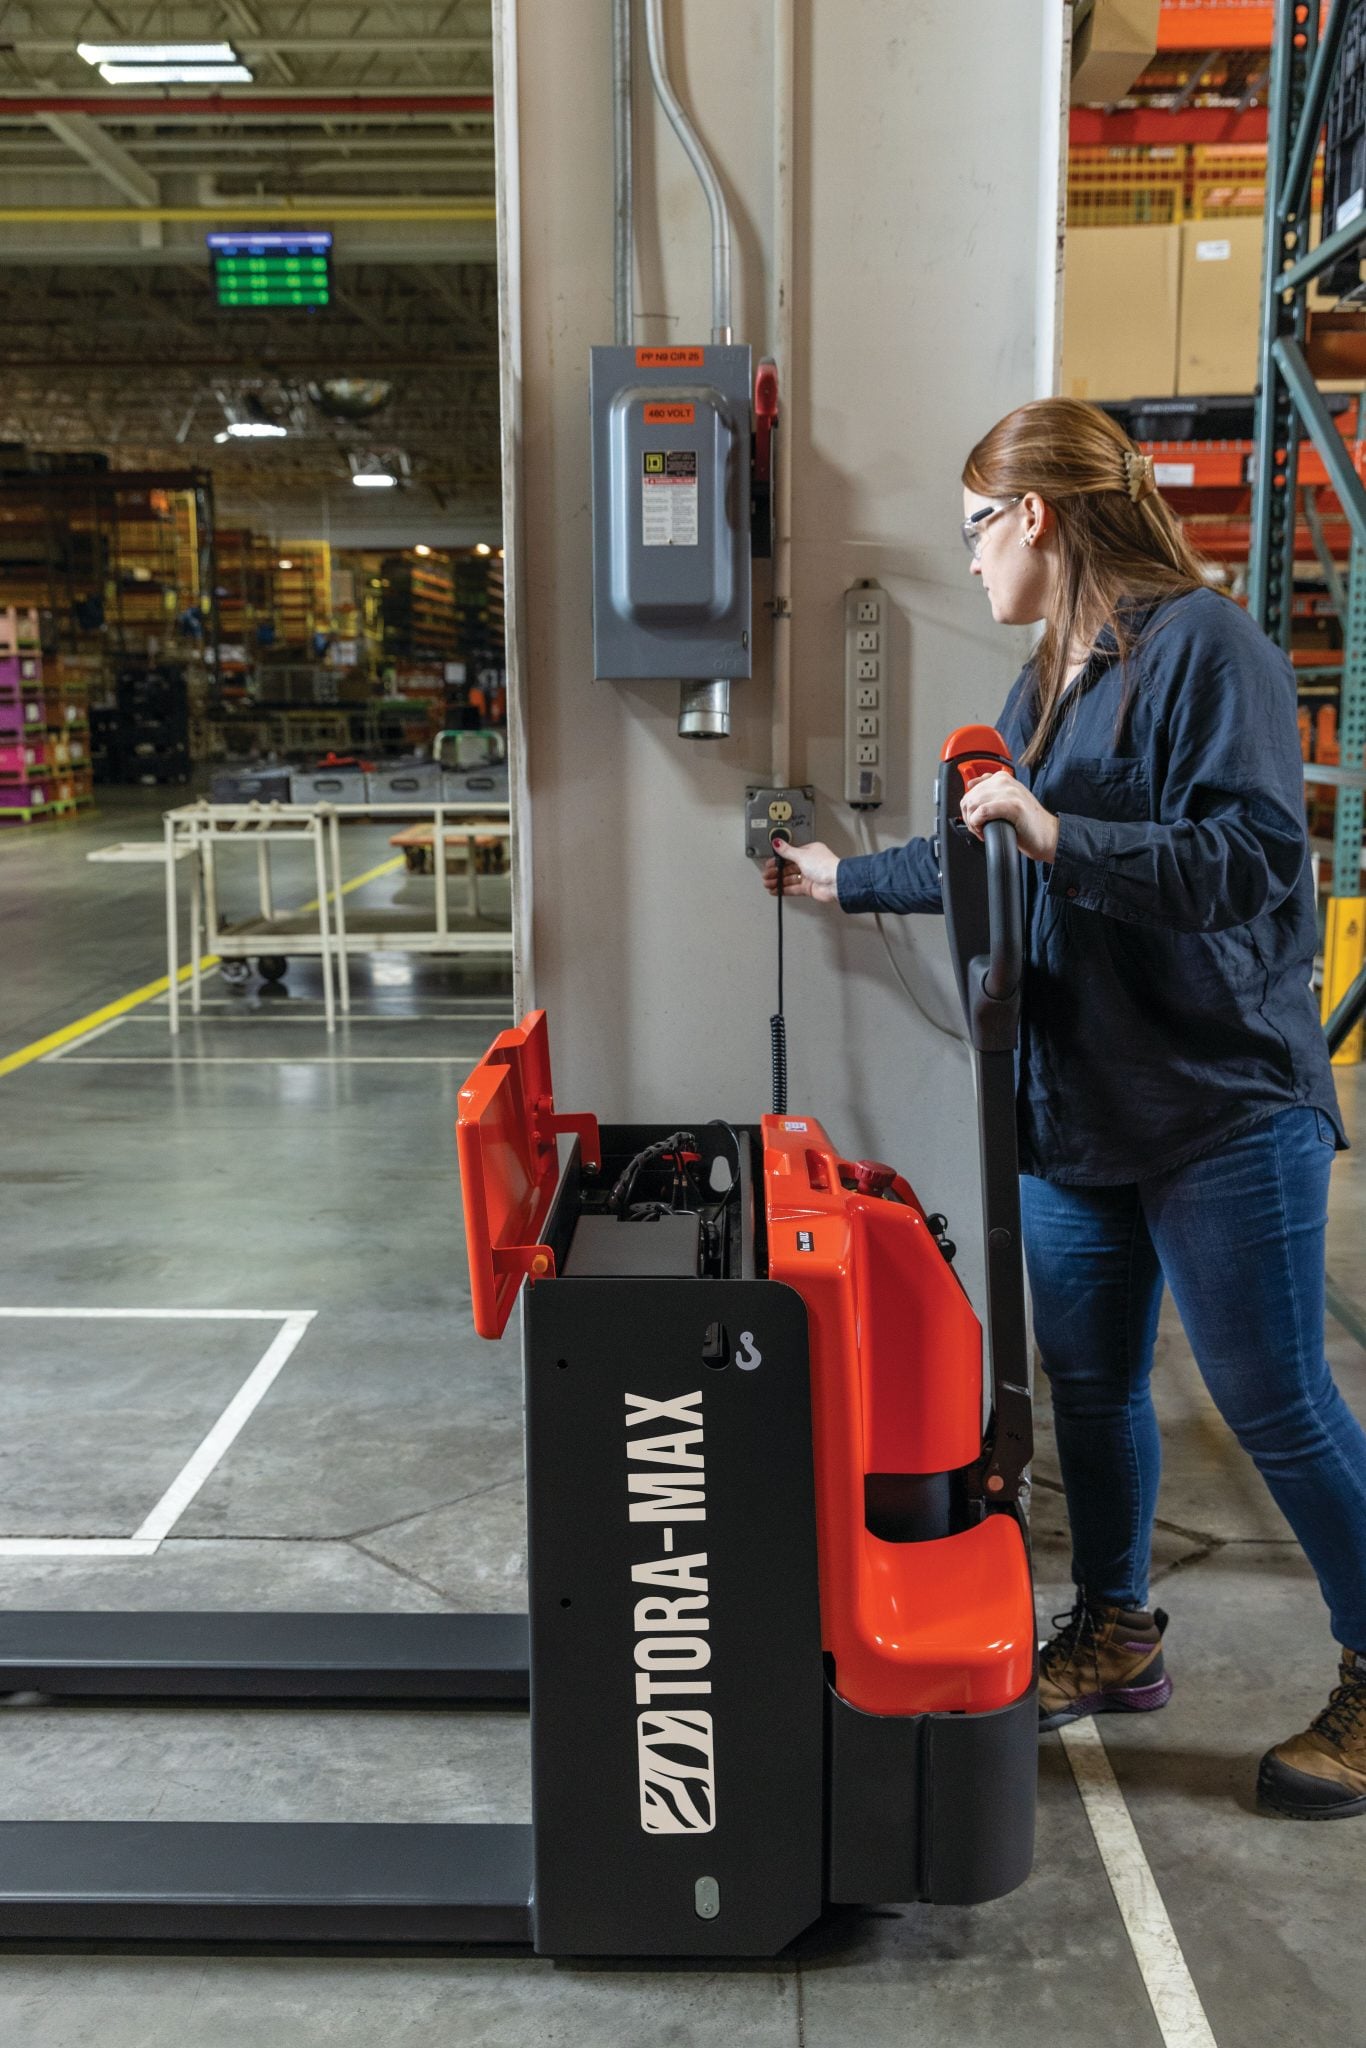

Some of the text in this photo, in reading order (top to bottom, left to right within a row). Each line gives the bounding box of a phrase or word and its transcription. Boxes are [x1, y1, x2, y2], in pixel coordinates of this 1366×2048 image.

[641, 352, 654, 361] PP
[670, 352, 686, 361] CIR
[648, 408, 691, 418] 480 VOLT
[625, 1390, 712, 1705] TORA-MAX
